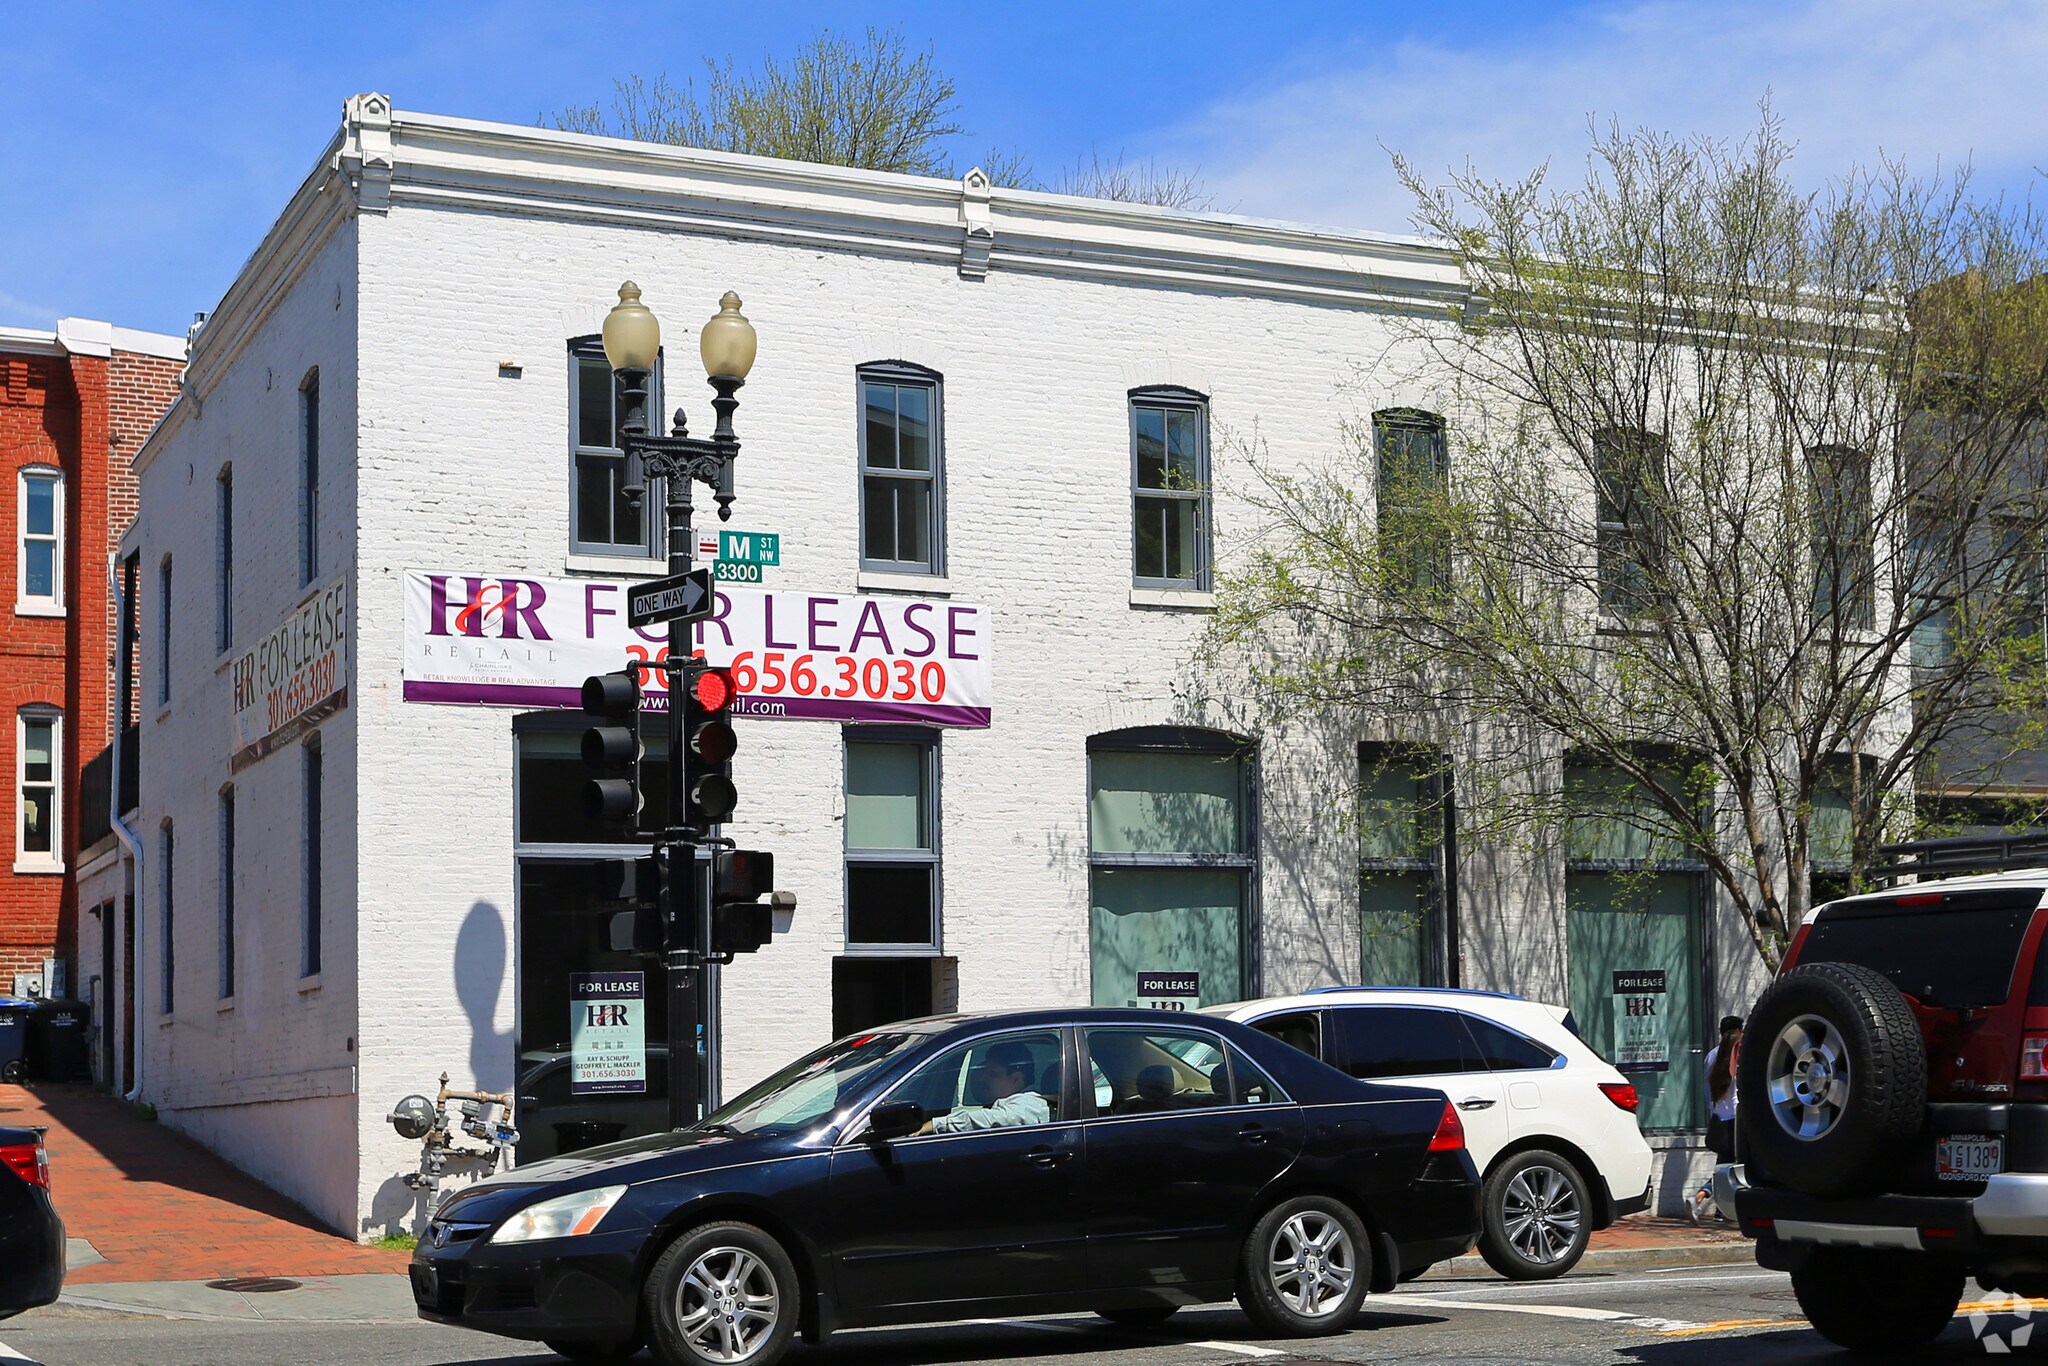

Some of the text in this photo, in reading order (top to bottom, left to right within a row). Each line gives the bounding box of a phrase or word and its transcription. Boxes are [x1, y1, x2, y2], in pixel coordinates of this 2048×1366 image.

[729, 535, 750, 560] M
[760, 537, 773, 548] ST
[759, 551, 774, 561] NW
[717, 563, 758, 581] 3300
[636, 587, 685, 614] ONE WAY
[585, 584, 979, 660] FR LEASE
[259, 582, 345, 695] FOR LEASE
[424, 644, 557, 662] RETAIL
[423, 673, 557, 685] RETAIL KNOWLEDGE REAL ADVANTAGE
[625, 644, 946, 703] 30656.3030
[267, 649, 337, 733] 301.656.3030
[579, 982, 639, 992] FOR LEASE
[1144, 981, 1195, 990] FOR LEASE
[581, 1070, 636, 1078] 301.656.3030
[1938, 1173, 1990, 1182] KOONSFORD.CO
